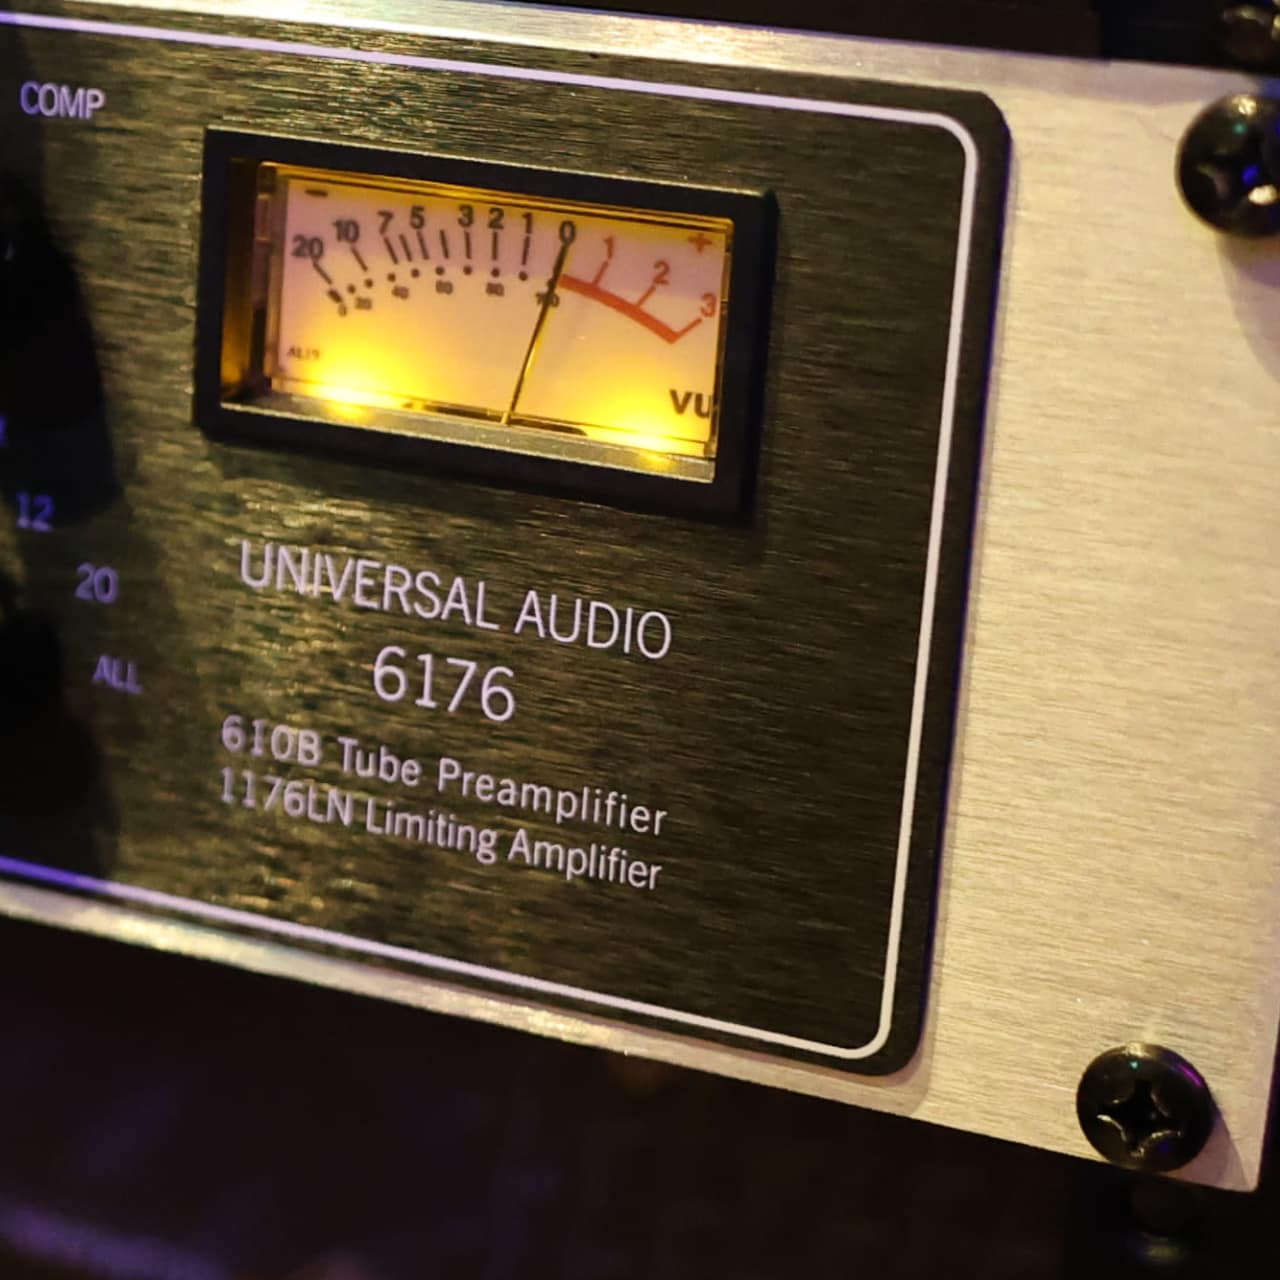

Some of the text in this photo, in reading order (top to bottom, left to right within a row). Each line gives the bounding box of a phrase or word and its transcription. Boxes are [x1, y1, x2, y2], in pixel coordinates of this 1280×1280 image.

[20, 81, 105, 119] COMP
[292, 204, 717, 317] 20 10 7 5 3 2 1 0 1 2 3
[669, 389, 713, 419] VU
[16, 491, 54, 532] 12
[75, 562, 120, 604] 20
[239, 539, 673, 660] UNIVERSAL AUDIO
[92, 655, 141, 694] ALL
[372, 646, 516, 722] 6176
[222, 715, 668, 836] 610B Tube Preamplifier
[221, 767, 662, 890] 1176LN Limiting Amplifier
